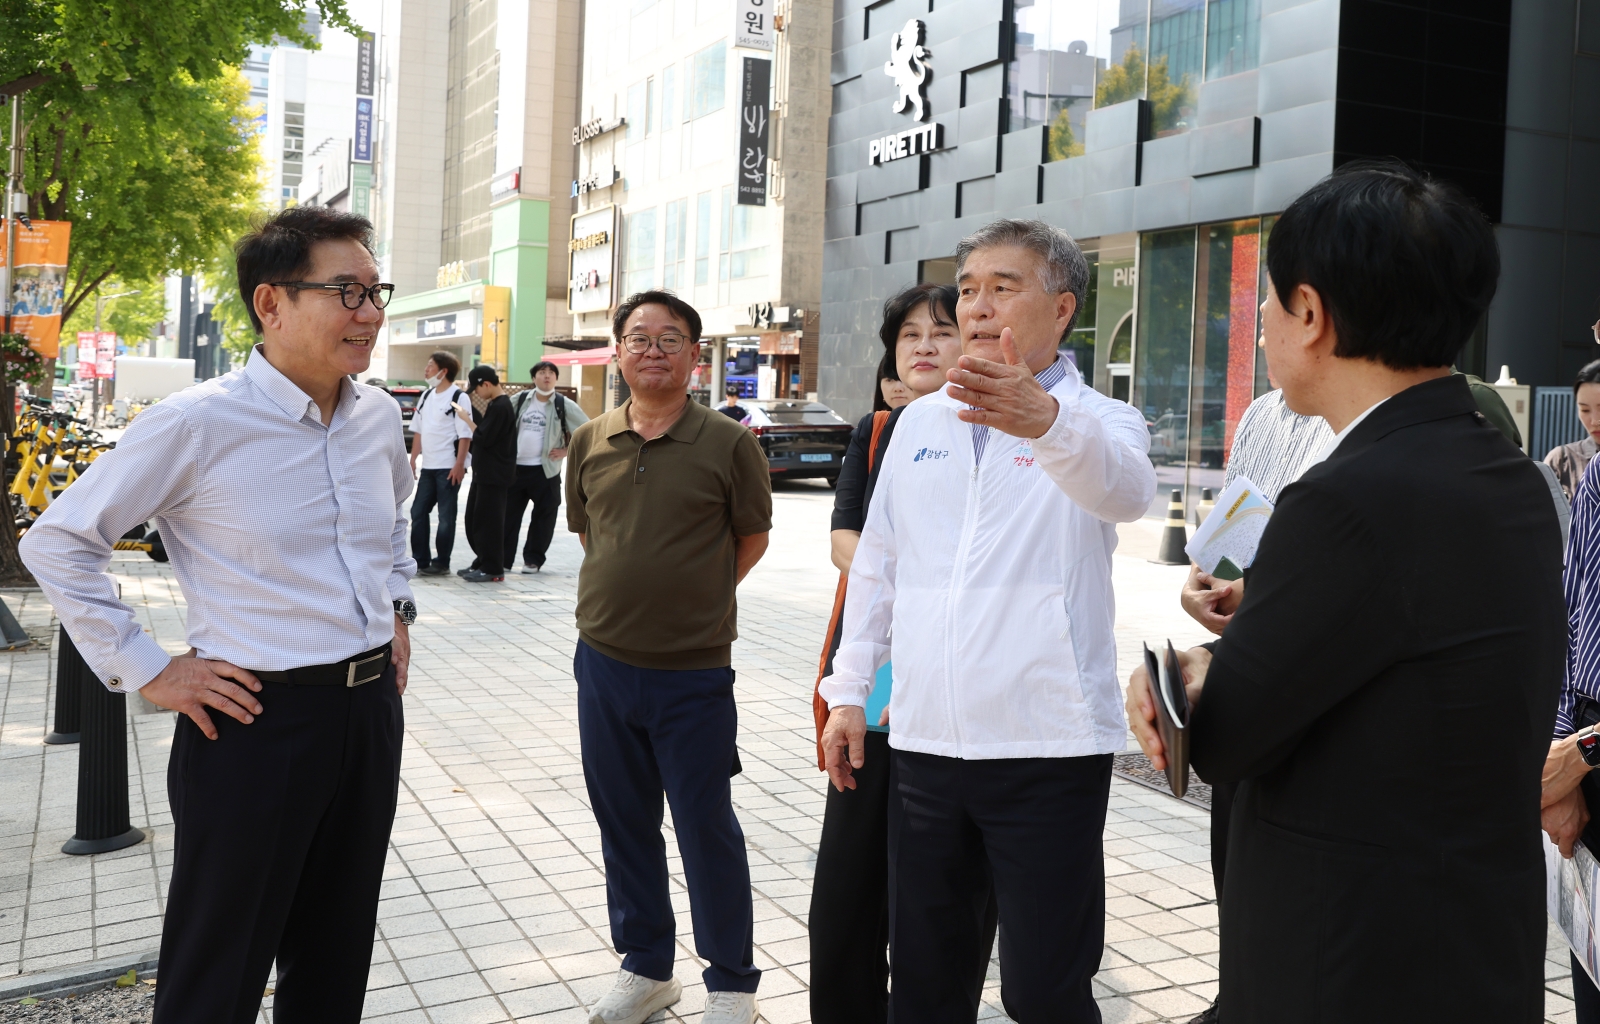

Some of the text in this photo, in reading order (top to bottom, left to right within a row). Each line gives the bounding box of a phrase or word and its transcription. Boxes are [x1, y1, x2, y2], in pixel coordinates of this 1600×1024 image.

[744, 0, 764, 36] 원
[868, 122, 938, 166] PIRETTI
[926, 449, 949, 459] 강남구
[1013, 455, 1035, 467] 강남
